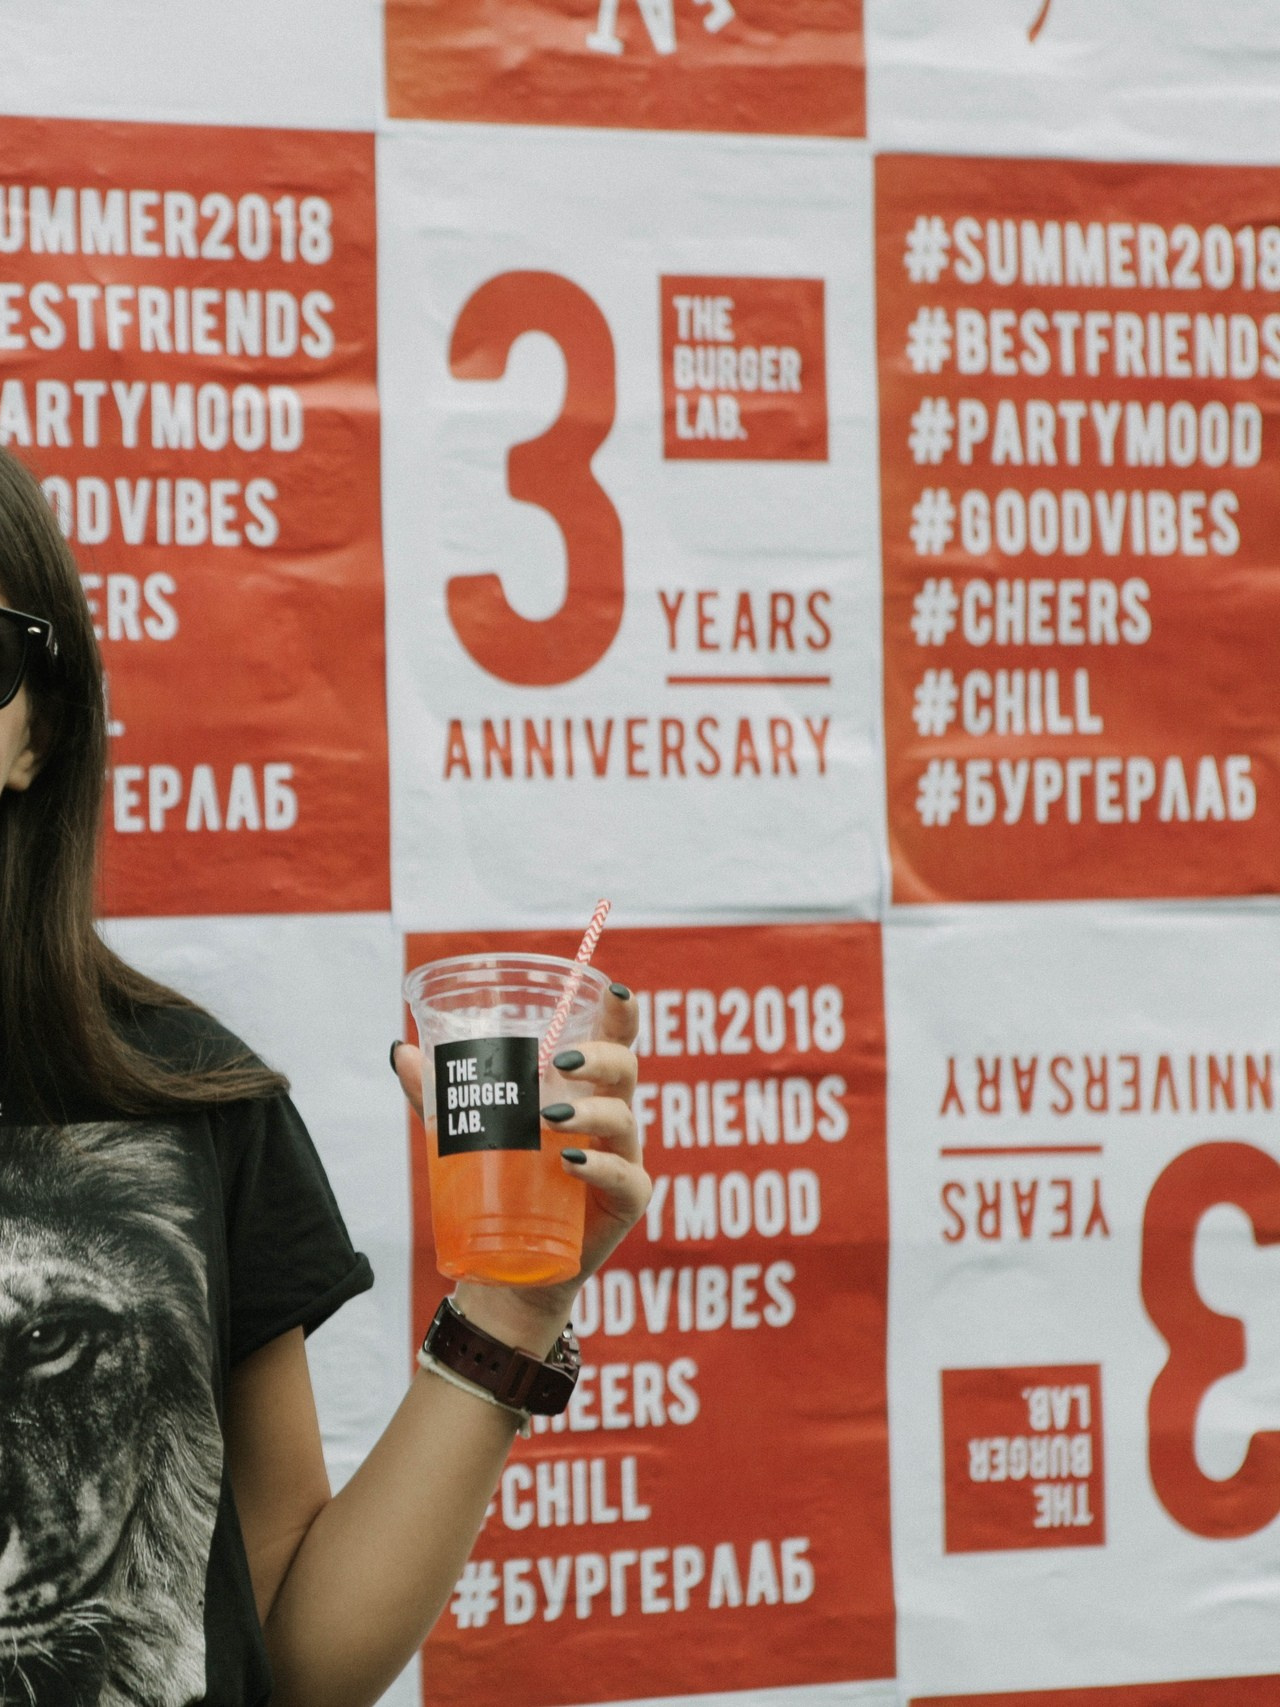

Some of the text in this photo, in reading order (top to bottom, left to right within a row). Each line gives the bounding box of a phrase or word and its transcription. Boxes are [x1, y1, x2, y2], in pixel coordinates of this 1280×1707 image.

[903, 217, 1280, 291] #SUMMER2018
[673, 296, 734, 342] THE
[906, 307, 1280, 379] #BESTFRIENDS
[673, 345, 801, 392] BURGER
[675, 394, 746, 440] LAB.
[908, 398, 1261, 467] #PARTYMOOD
[40, 476, 278, 547] ODVIBES
[445, 269, 626, 689] 3
[909, 489, 1239, 556] #GOODVIBES
[659, 590, 832, 652] YEARS
[911, 579, 1151, 645] #CHEERS
[912, 670, 1102, 737] #CHILL
[444, 716, 830, 779] ANNIVERSARY
[916, 756, 1256, 826] #БУРГЕРЛАБ
[446, 1057, 478, 1083] THE
[447, 1081, 519, 1110] BURGER
[939, 1054, 1274, 1116] NNIVERSARY
[448, 1109, 485, 1136] LAB.
[630, 1074, 849, 1150] FRIENDS
[645, 1168, 821, 1242] YMOOD
[940, 1178, 1109, 1243] YEARS
[1138, 1140, 1280, 1541] 3
[1023, 1385, 1090, 1430] LAB.
[969, 1434, 1091, 1481] BURGER
[478, 1456, 651, 1531] CHILL
[1034, 1484, 1092, 1527] THE
[451, 1538, 813, 1628] #БУРГЕРЛАБ
